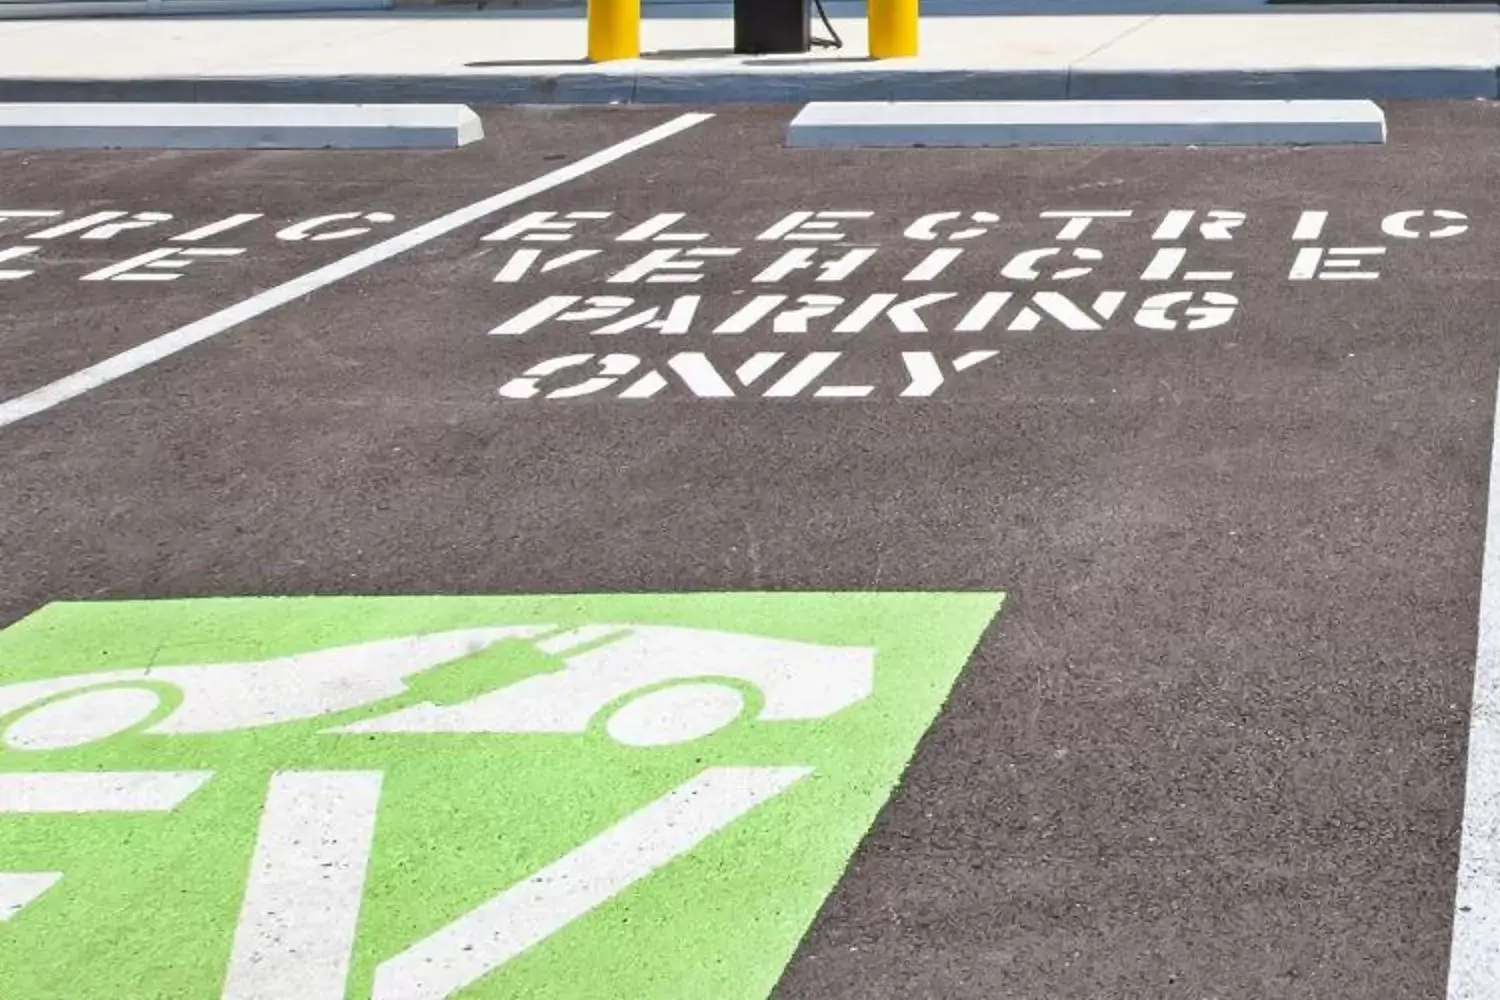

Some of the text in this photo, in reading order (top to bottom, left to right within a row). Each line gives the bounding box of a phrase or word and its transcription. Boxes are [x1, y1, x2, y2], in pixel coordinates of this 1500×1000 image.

[480, 210, 1469, 242] ELECTRIC
[493, 247, 1387, 283] VEHICLE
[487, 291, 1239, 335] PARKING
[498, 350, 1000, 399] ONLY
